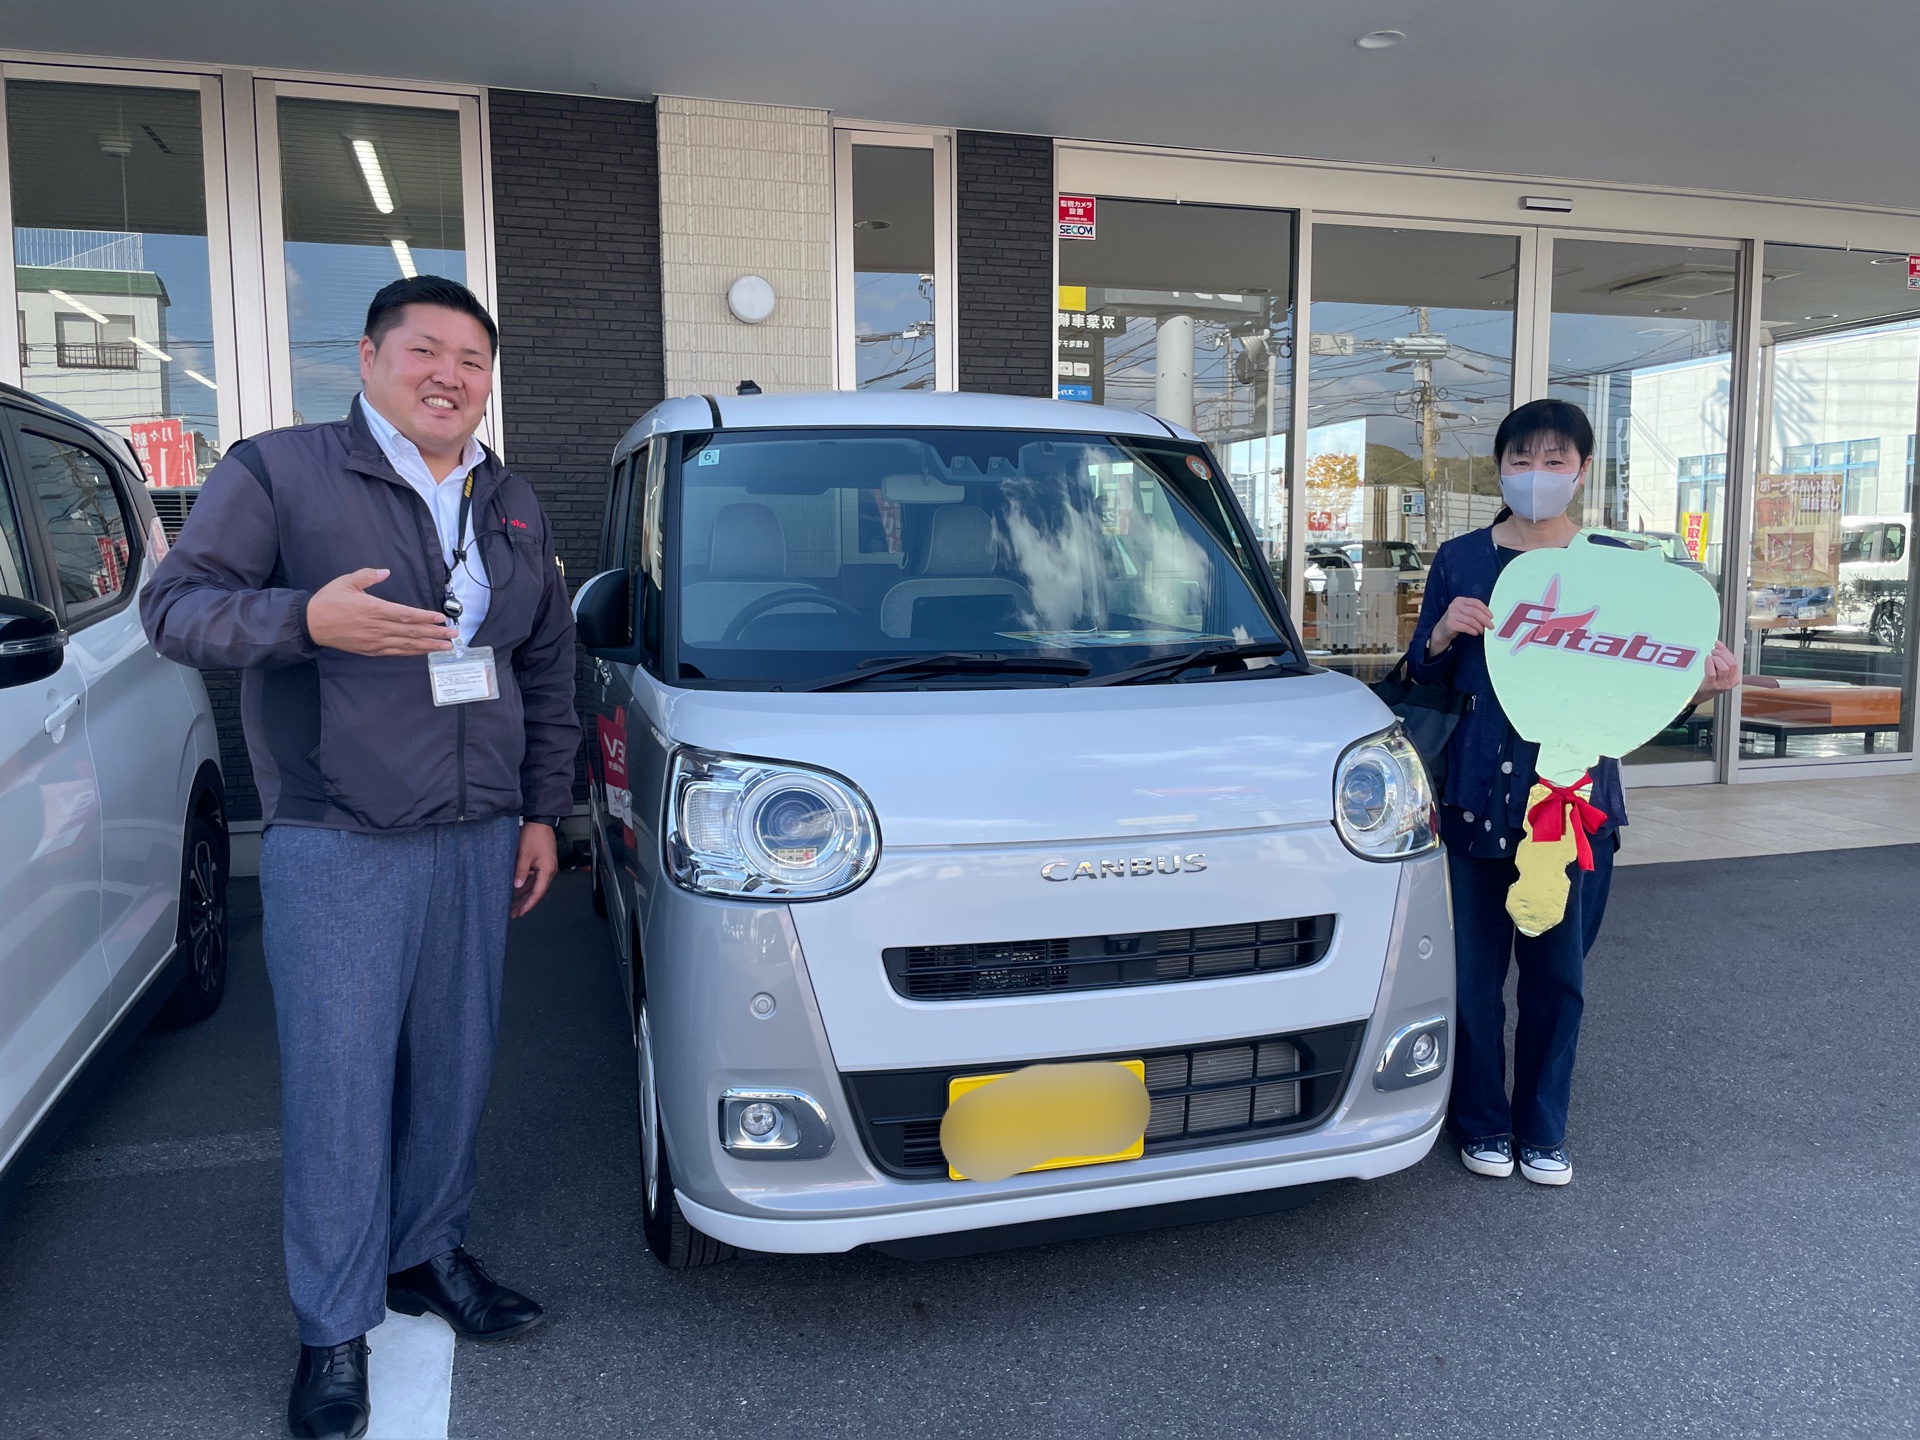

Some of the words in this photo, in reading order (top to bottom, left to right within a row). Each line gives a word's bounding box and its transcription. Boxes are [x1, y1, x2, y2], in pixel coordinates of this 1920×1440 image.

[1060, 225, 1093, 235] SECOM
[704, 451, 712, 461] 6
[1498, 603, 1697, 669] Futaba
[1040, 853, 1208, 882] CANBUS
